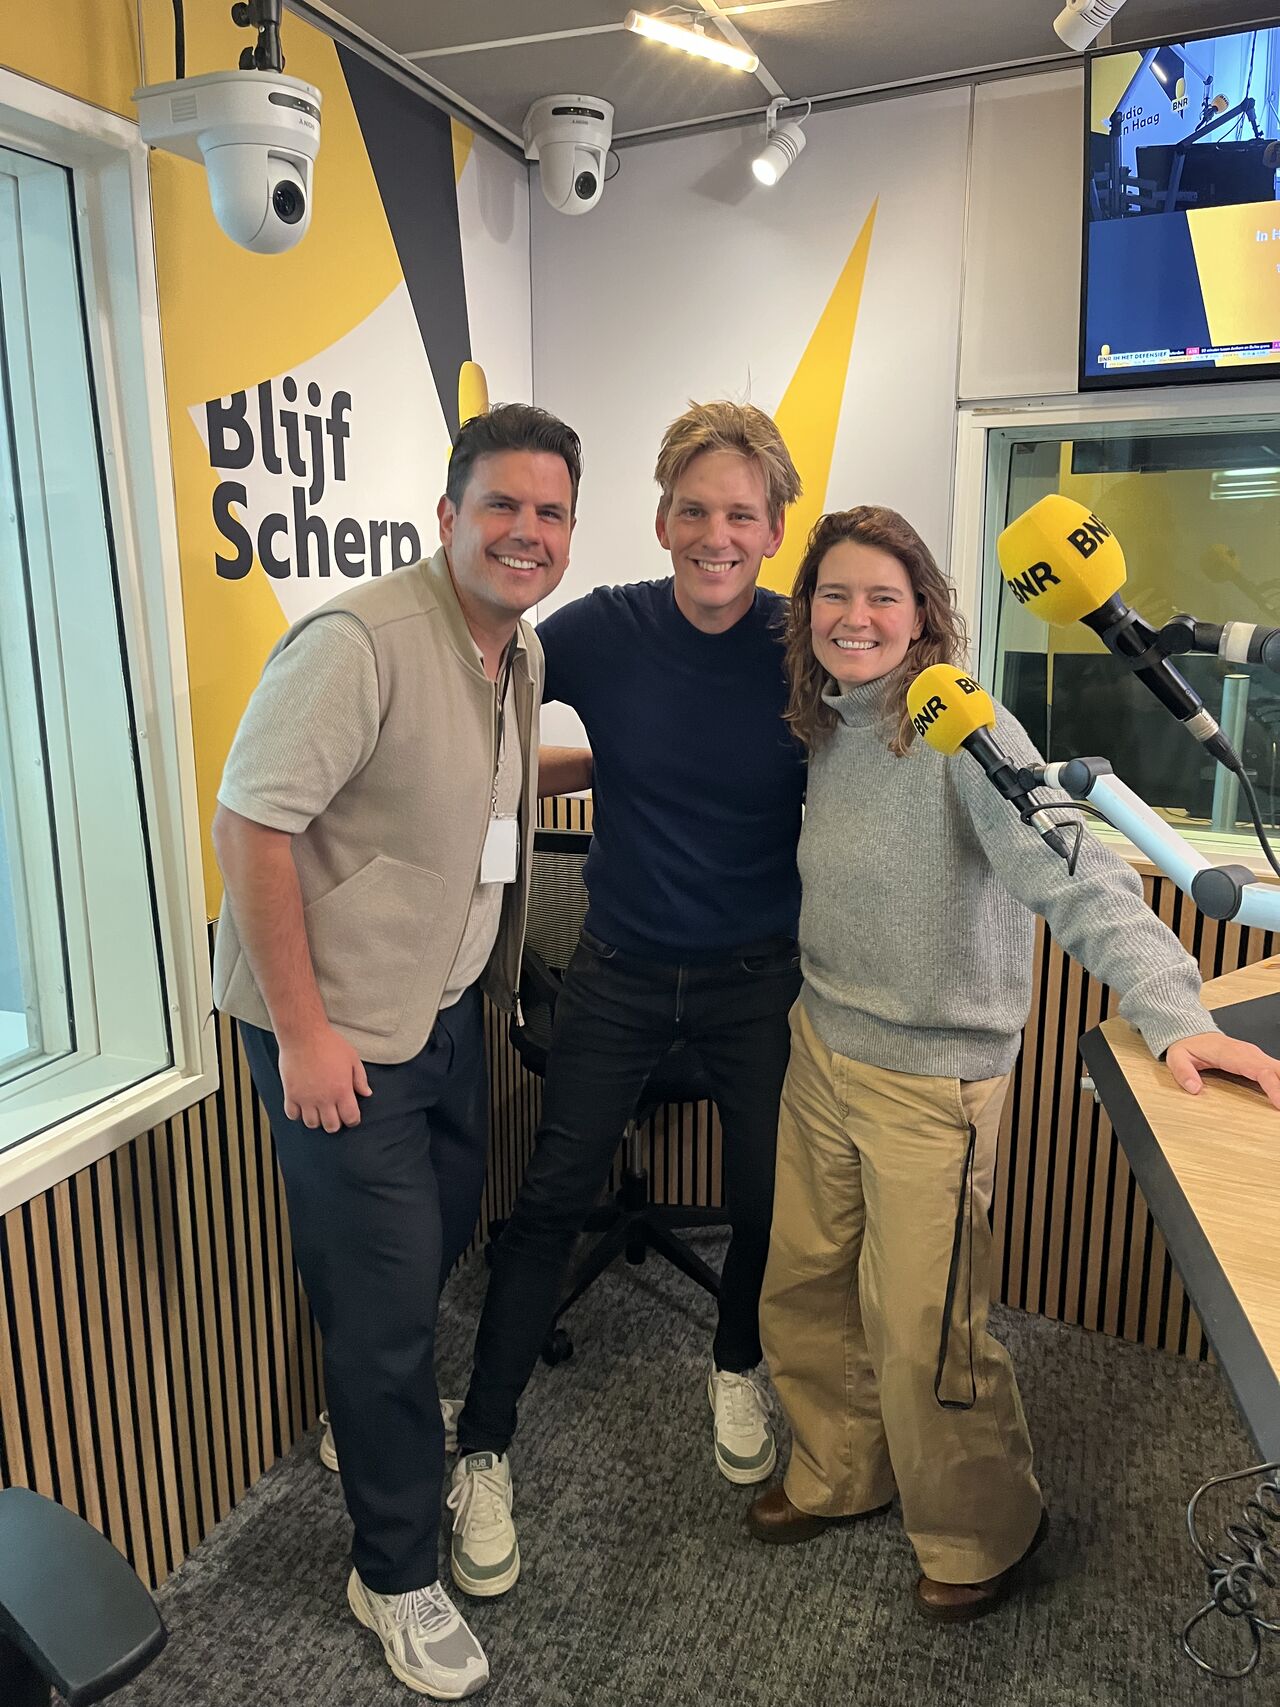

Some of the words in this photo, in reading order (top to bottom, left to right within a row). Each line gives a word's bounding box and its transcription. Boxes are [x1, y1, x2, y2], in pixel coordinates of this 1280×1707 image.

[1121, 105, 1143, 122] udio
[1172, 98, 1188, 110] BNR
[1132, 112, 1160, 131] Haag
[1134, 351, 1167, 359] DEFENSIEF
[205, 375, 352, 506] Blijf
[212, 481, 421, 580] Scherp
[1066, 513, 1112, 559] BN
[1007, 560, 1061, 604] BNR
[954, 677, 985, 695] BN
[913, 695, 948, 737] BNR
